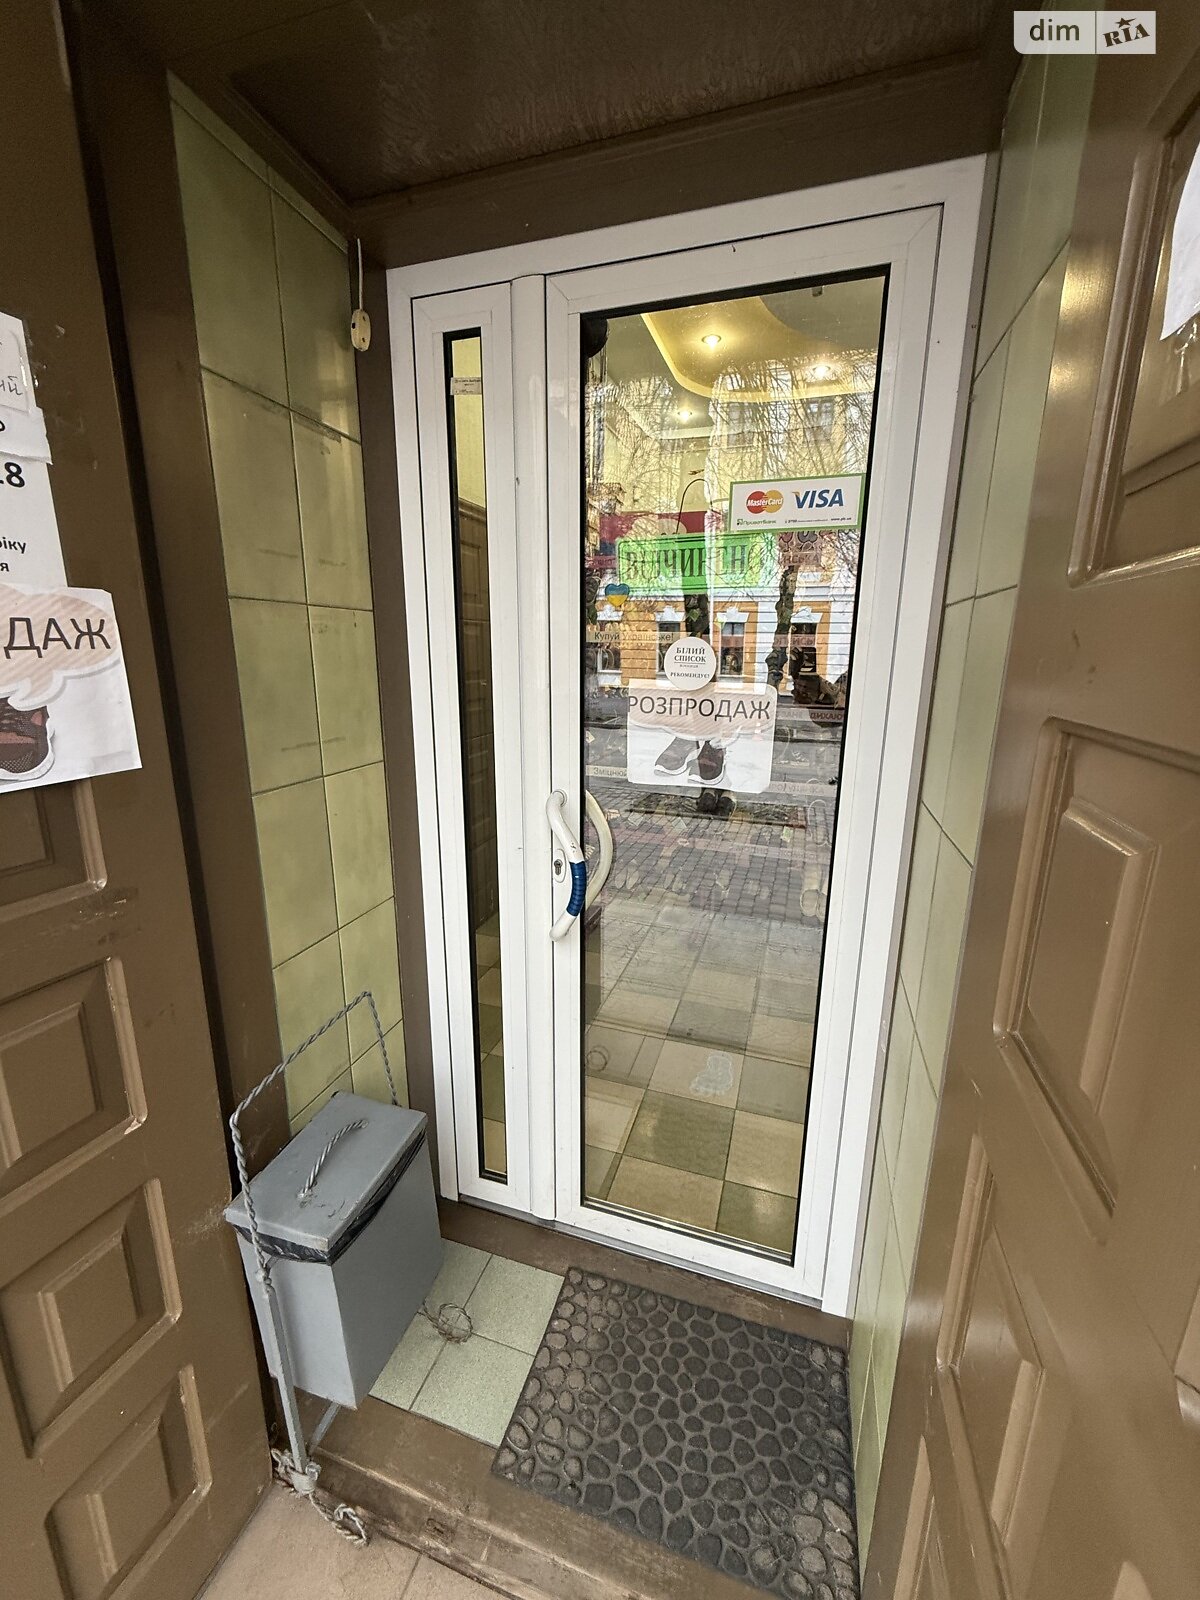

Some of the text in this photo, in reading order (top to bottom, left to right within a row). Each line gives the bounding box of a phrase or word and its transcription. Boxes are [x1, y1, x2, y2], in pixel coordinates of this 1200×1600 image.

[747, 488, 845, 509] MasterCard VISA
[594, 631, 620, 642] Купуй
[676, 647, 706, 656] БІЛИЙ
[674, 655, 707, 663] СПИСОК
[628, 696, 771, 722] РОЗПРОДАЖ
